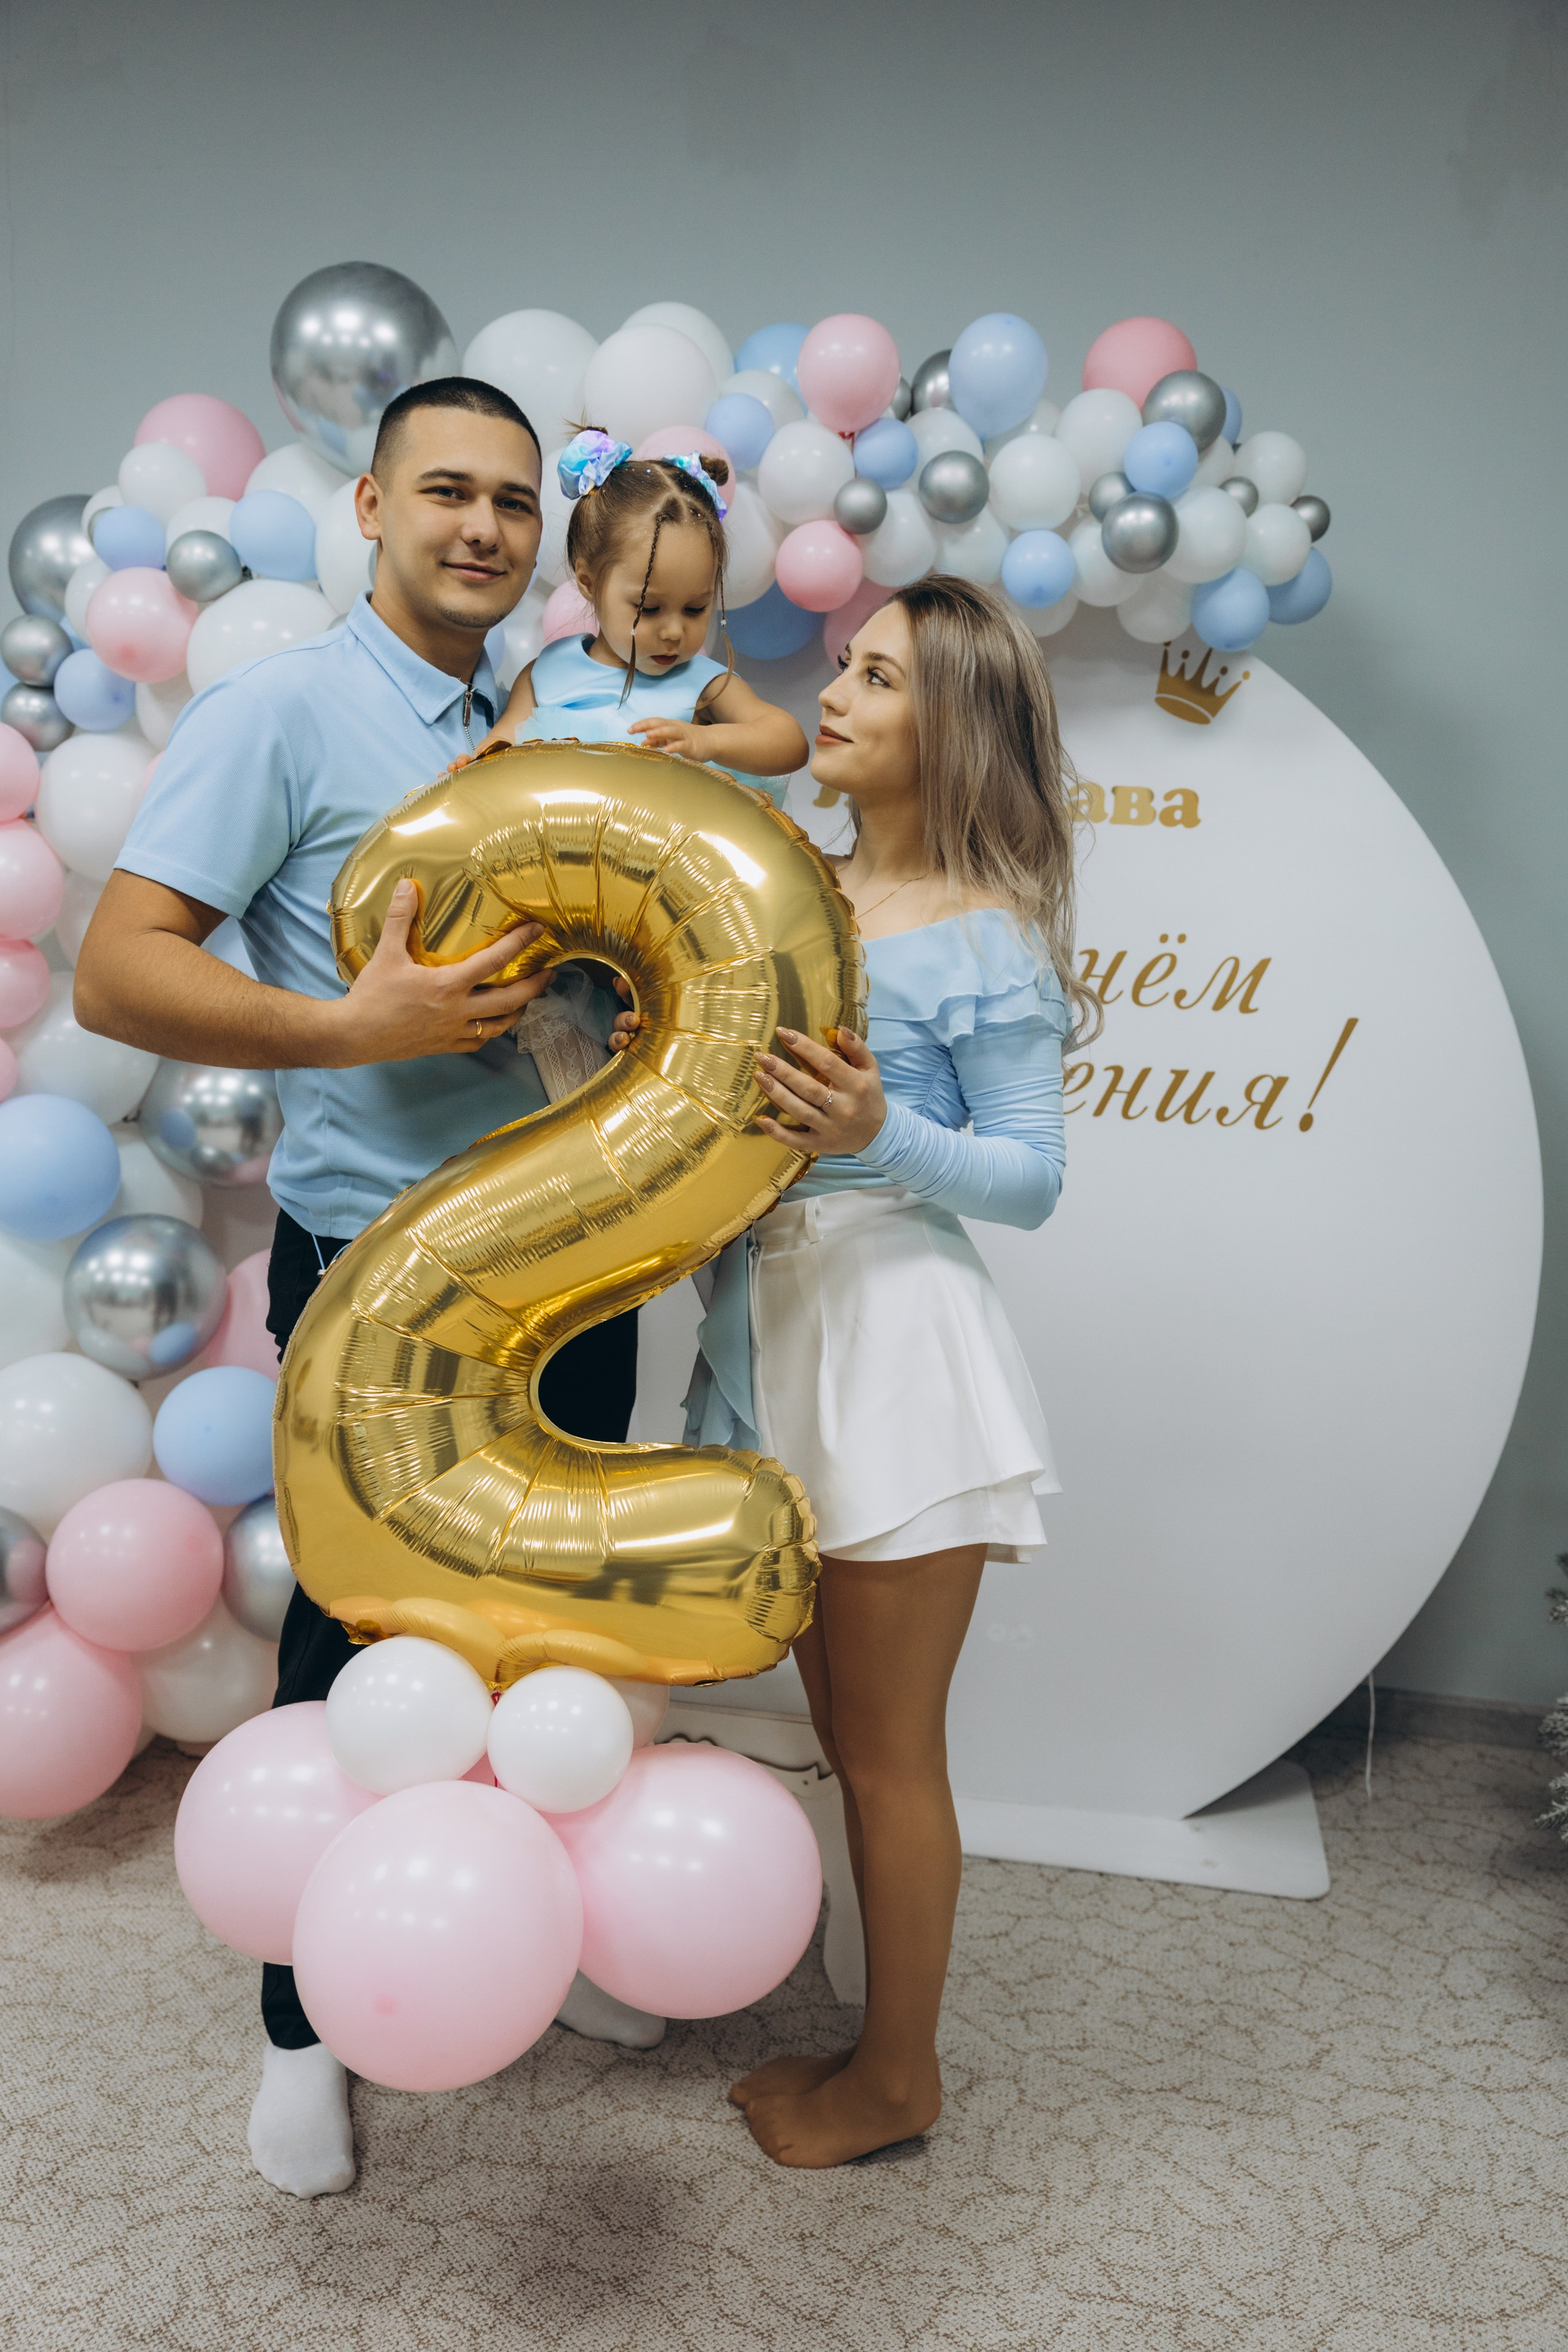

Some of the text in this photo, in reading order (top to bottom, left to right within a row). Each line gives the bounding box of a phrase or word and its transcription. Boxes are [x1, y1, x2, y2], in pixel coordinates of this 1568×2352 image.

[1066, 781, 1202, 829] ава
[1078, 933, 1272, 1014] нём
[1062, 1017, 1360, 1133] ения!
[273, 738, 870, 1688] 2
